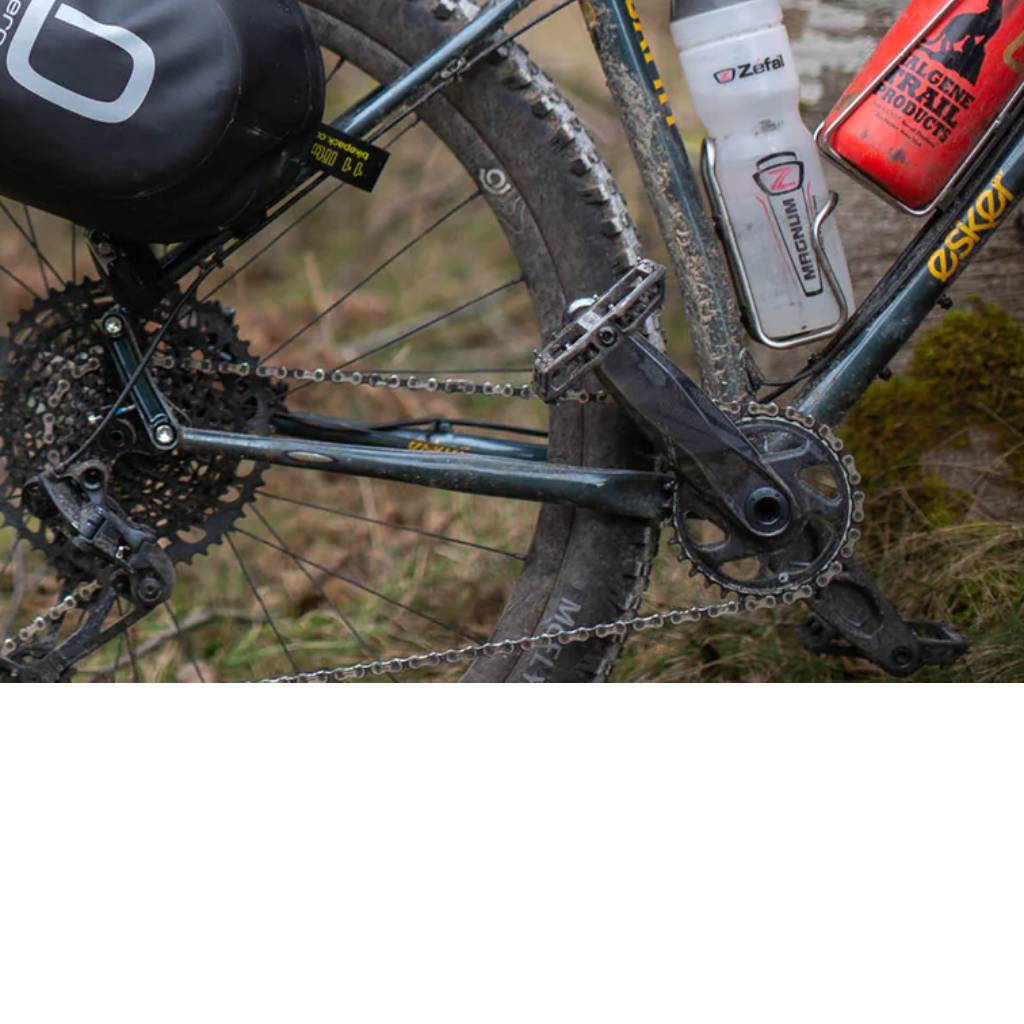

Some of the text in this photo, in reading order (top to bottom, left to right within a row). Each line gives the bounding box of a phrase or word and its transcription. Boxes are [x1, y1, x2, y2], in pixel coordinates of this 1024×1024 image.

[898, 54, 975, 111] ALGENE
[782, 197, 817, 282] MAGNUM
[928, 169, 1015, 283] esker
